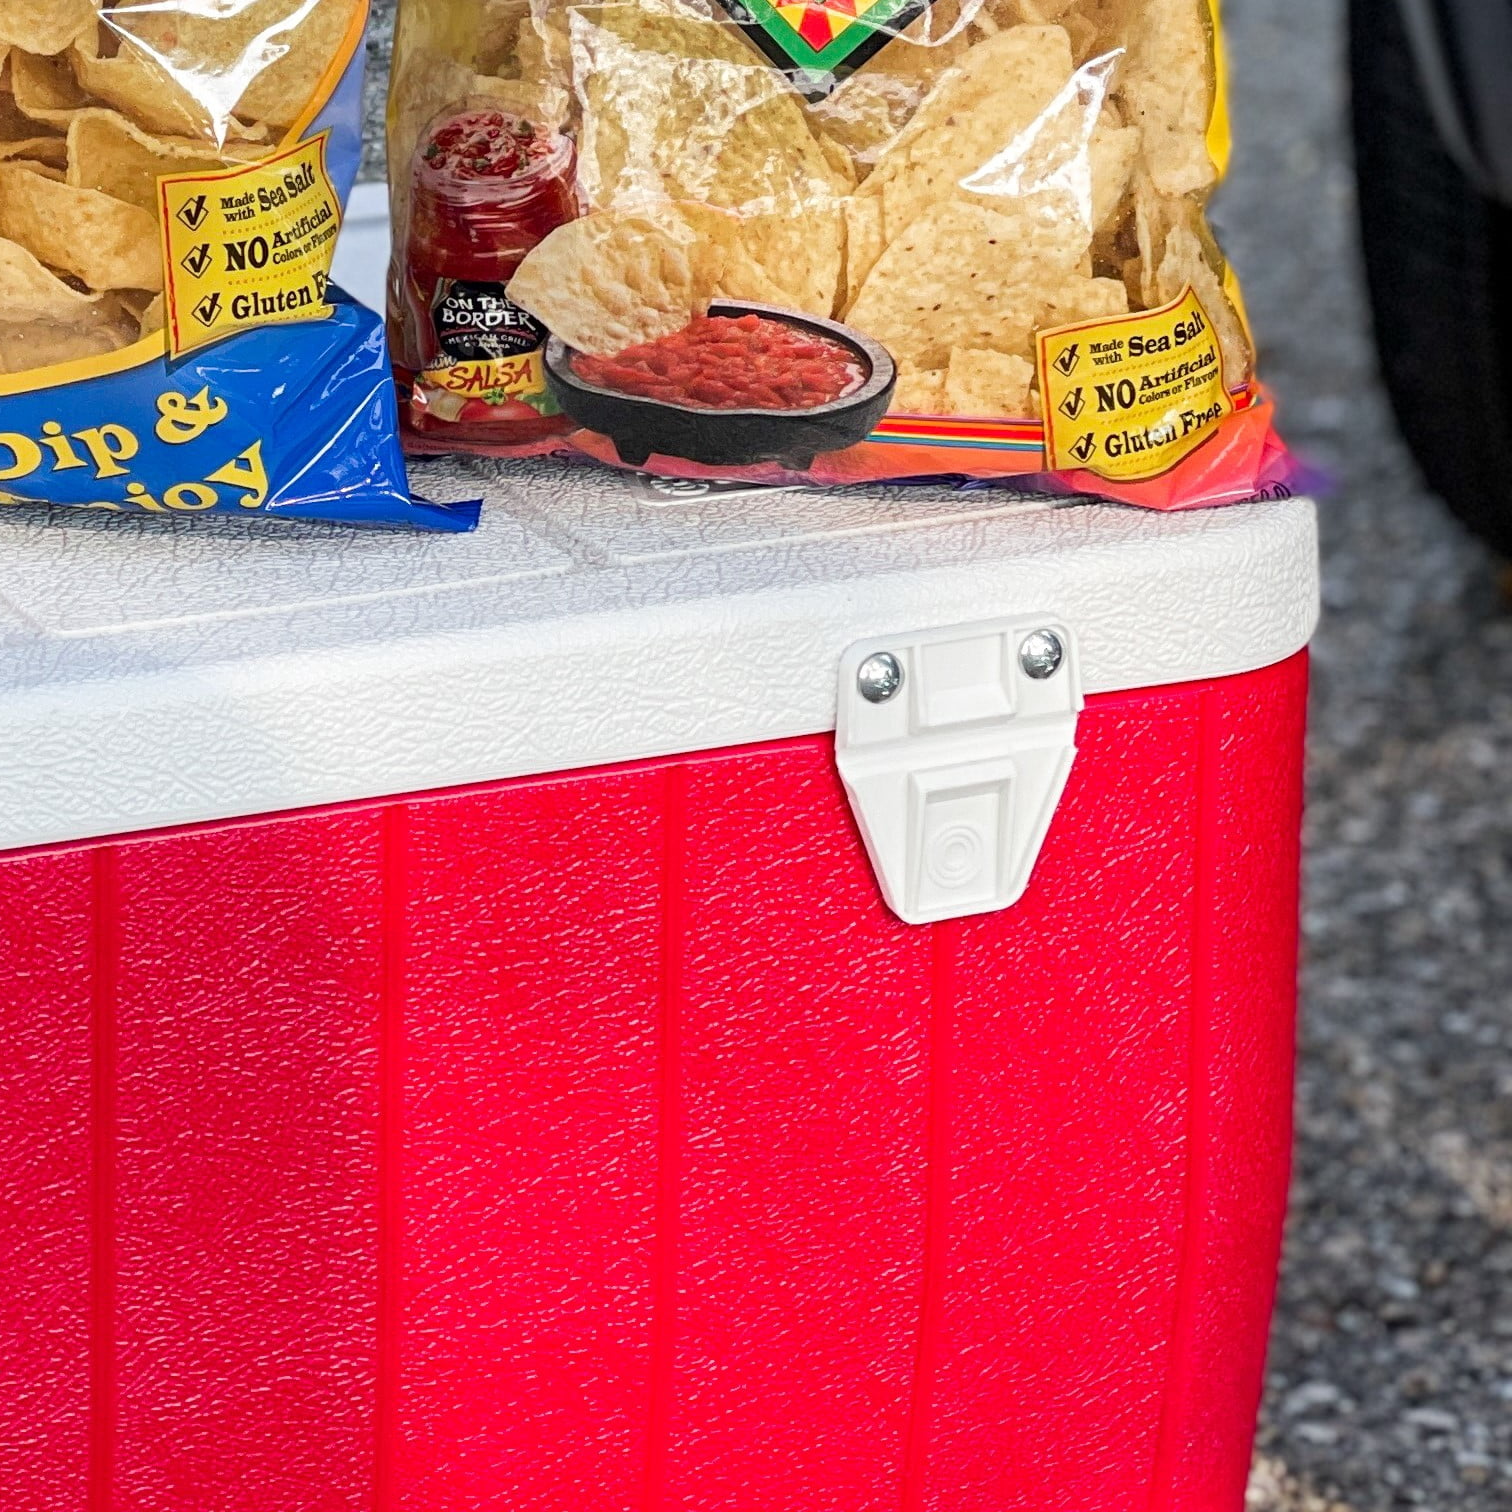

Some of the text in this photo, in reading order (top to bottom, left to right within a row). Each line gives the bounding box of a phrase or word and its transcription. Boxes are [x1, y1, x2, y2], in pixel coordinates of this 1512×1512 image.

[220, 160, 316, 212] Made Sea Salt
[224, 207, 255, 223] with
[224, 201, 333, 272] NO Artificial
[273, 247, 303, 265] Colors
[303, 243, 312, 254] or
[232, 286, 312, 319] Gluten
[442, 309, 536, 331] BORDER
[446, 297, 516, 311] ON THE
[1089, 311, 1206, 357] Made Sea Salt
[447, 359, 532, 391] SALSA
[1092, 351, 1122, 366] with
[1095, 345, 1216, 413] NO Artificial
[1138, 367, 1219, 405] Colors or Flavors
[155, 385, 228, 444] &
[1104, 402, 1223, 458] Gluten Free
